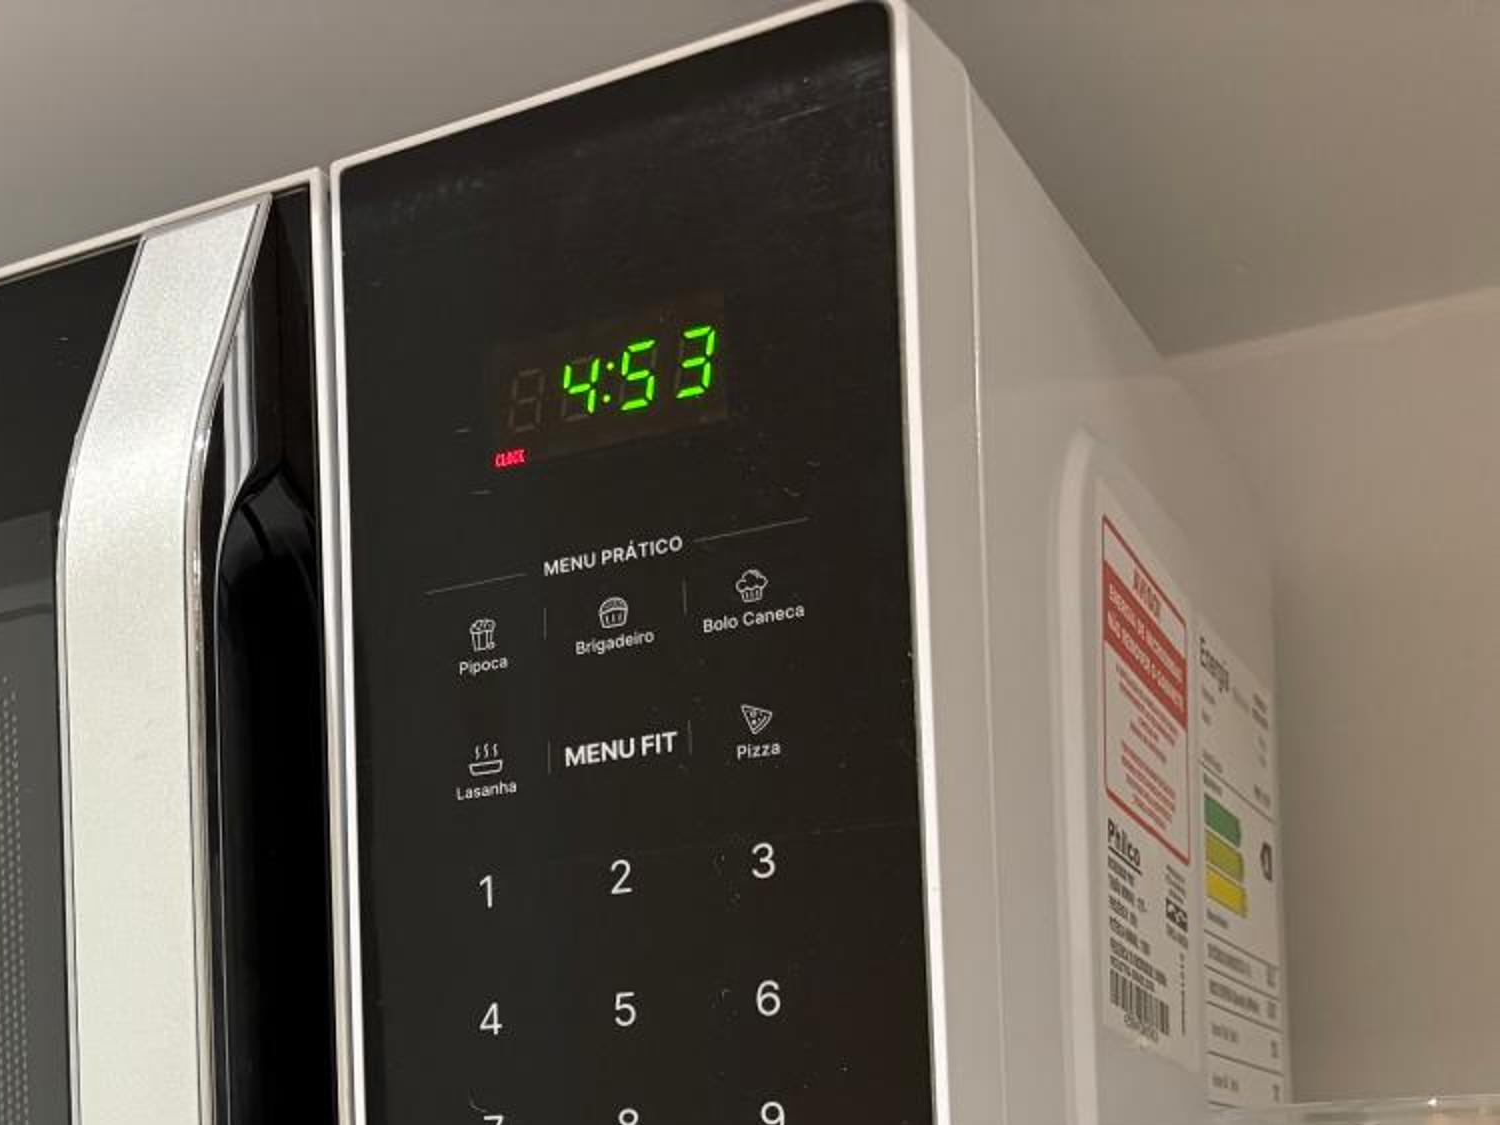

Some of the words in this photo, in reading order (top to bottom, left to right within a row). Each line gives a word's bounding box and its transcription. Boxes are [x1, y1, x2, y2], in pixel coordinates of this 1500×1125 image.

[562, 325, 716, 414] 4:53
[543, 551, 596, 577] MENU
[601, 535, 683, 566] PRÁTICO
[702, 615, 739, 633] Bolo
[741, 604, 805, 627] Caneca
[575, 630, 655, 655] Brigadeiro
[459, 656, 509, 677] Pipoca
[564, 739, 635, 767] MENU
[640, 730, 678, 757] FIT
[736, 742, 781, 760] Pizza
[456, 780, 517, 801] Lasanha
[610, 859, 633, 895] 2
[752, 842, 776, 879] 3
[479, 875, 494, 909] 1
[614, 991, 637, 1027] 5
[755, 979, 781, 1017] 6
[479, 1002, 503, 1036] 4
